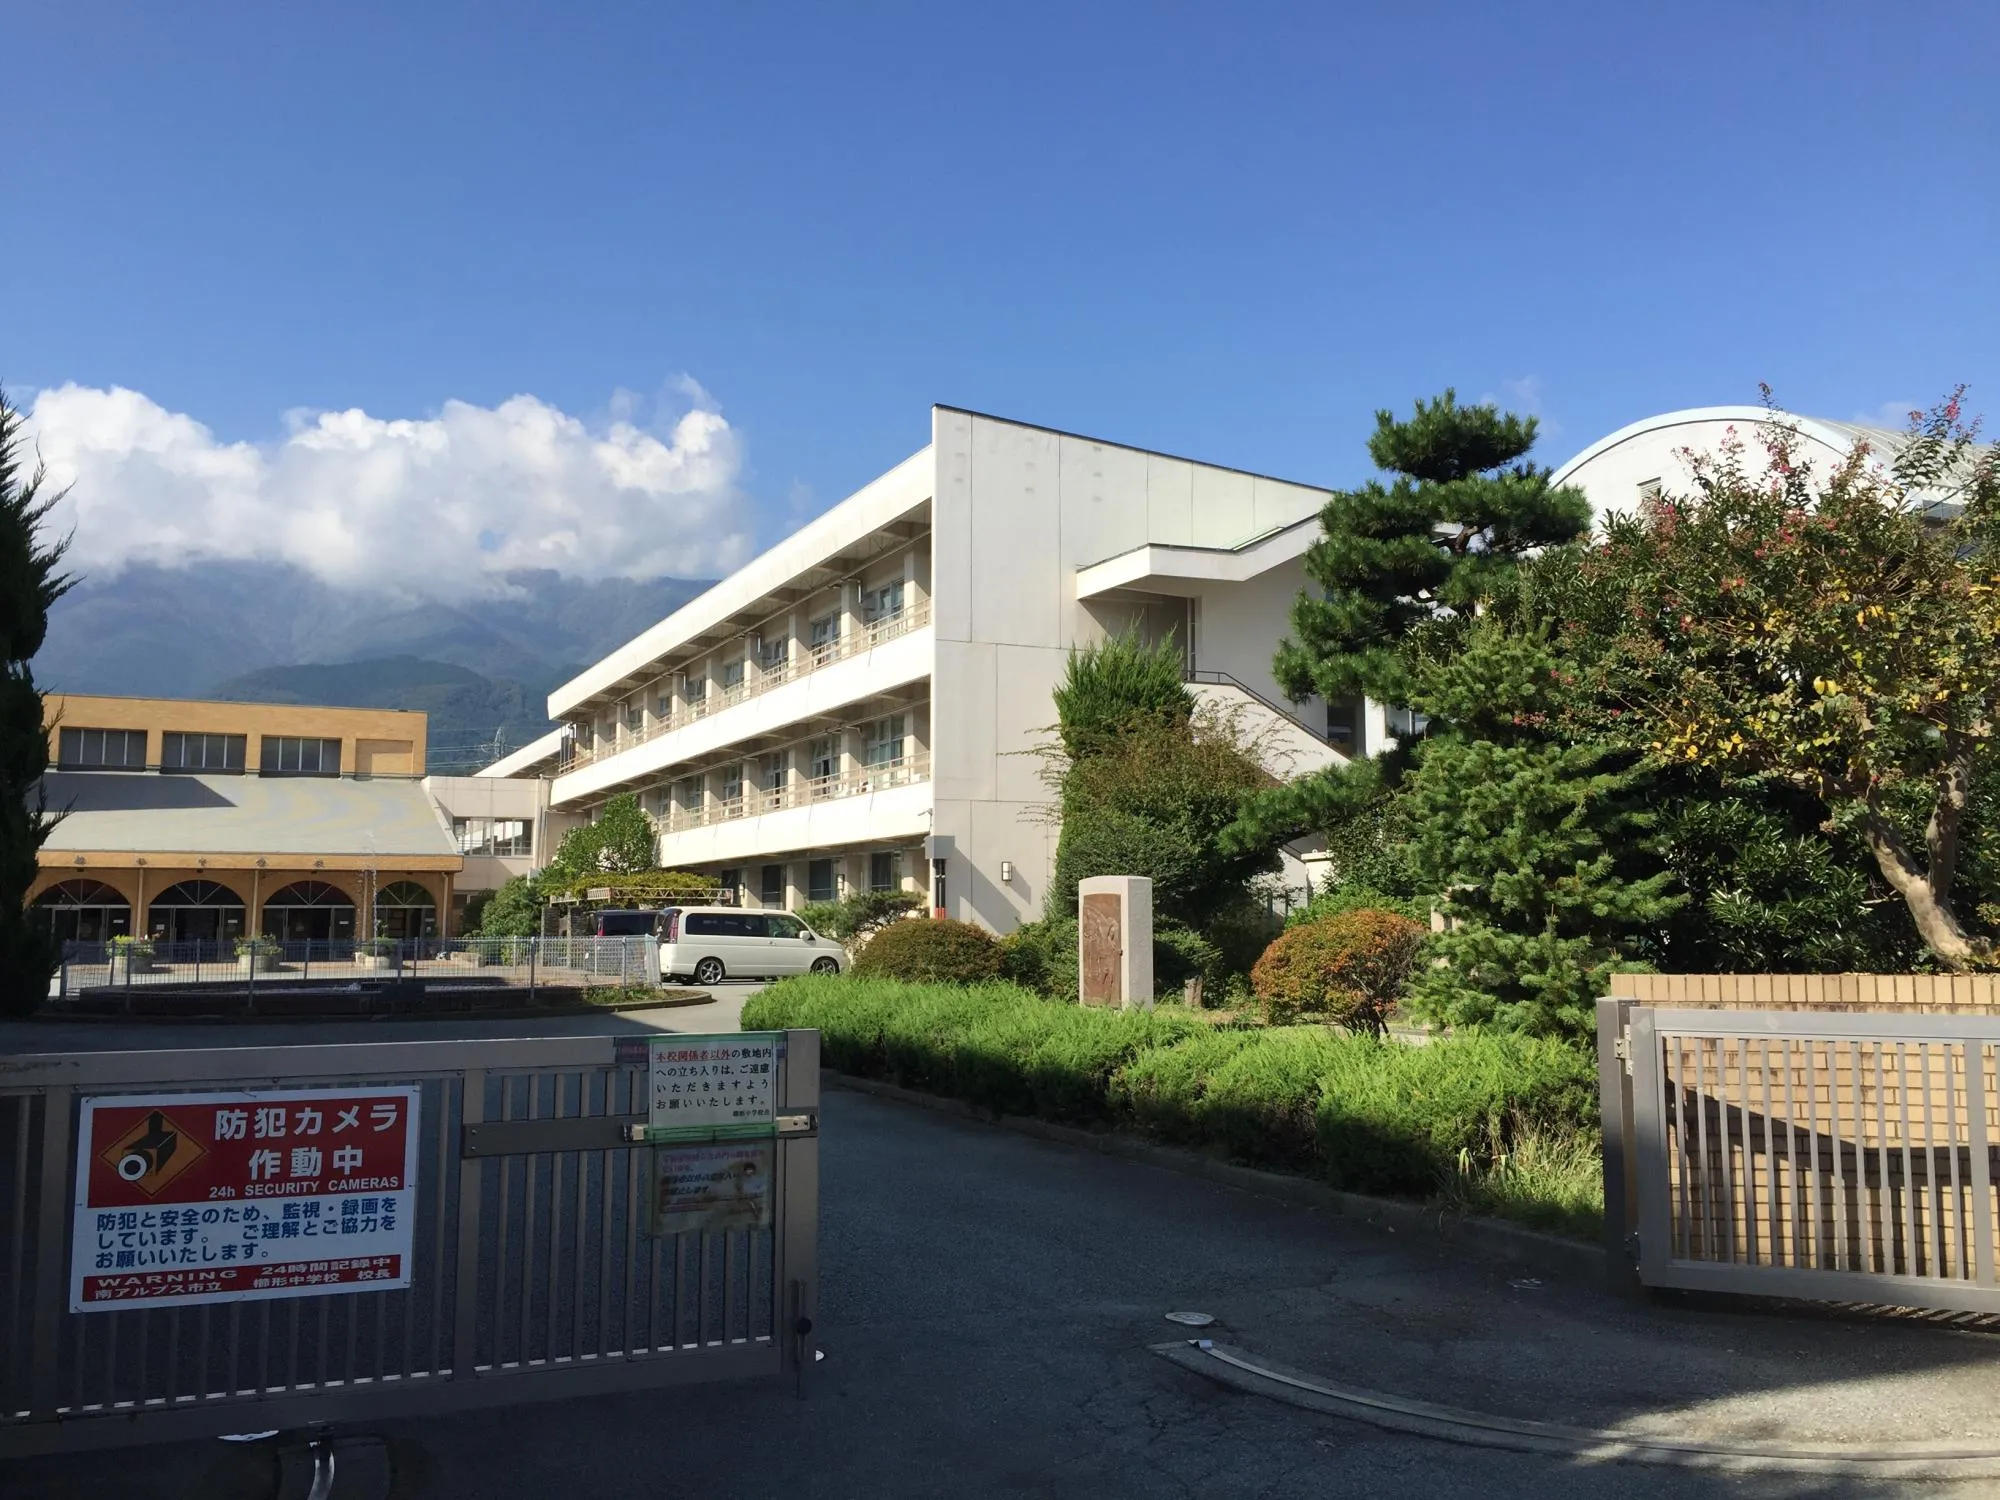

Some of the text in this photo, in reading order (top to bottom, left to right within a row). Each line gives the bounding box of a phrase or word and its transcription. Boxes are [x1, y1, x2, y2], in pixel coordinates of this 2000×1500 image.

[656, 1079, 769, 1092] いただきますよう
[656, 1095, 765, 1110] お願いいたします。
[215, 1104, 398, 1140] 防犯カメラ
[249, 1145, 363, 1180] 作動中
[209, 1176, 399, 1199] 24h SECURITY CAMERAS
[97, 1197, 397, 1231] 防犯と安全のため、監視・録画を
[99, 1215, 396, 1250] しています。 ご理解とご協力を
[95, 1243, 269, 1270] お願いいたします。
[261, 1257, 391, 1276] 24時間記録中
[99, 1270, 238, 1287] WARNING
[358, 1269, 391, 1280] 校長
[95, 1282, 223, 1300] 南アルプス市立
